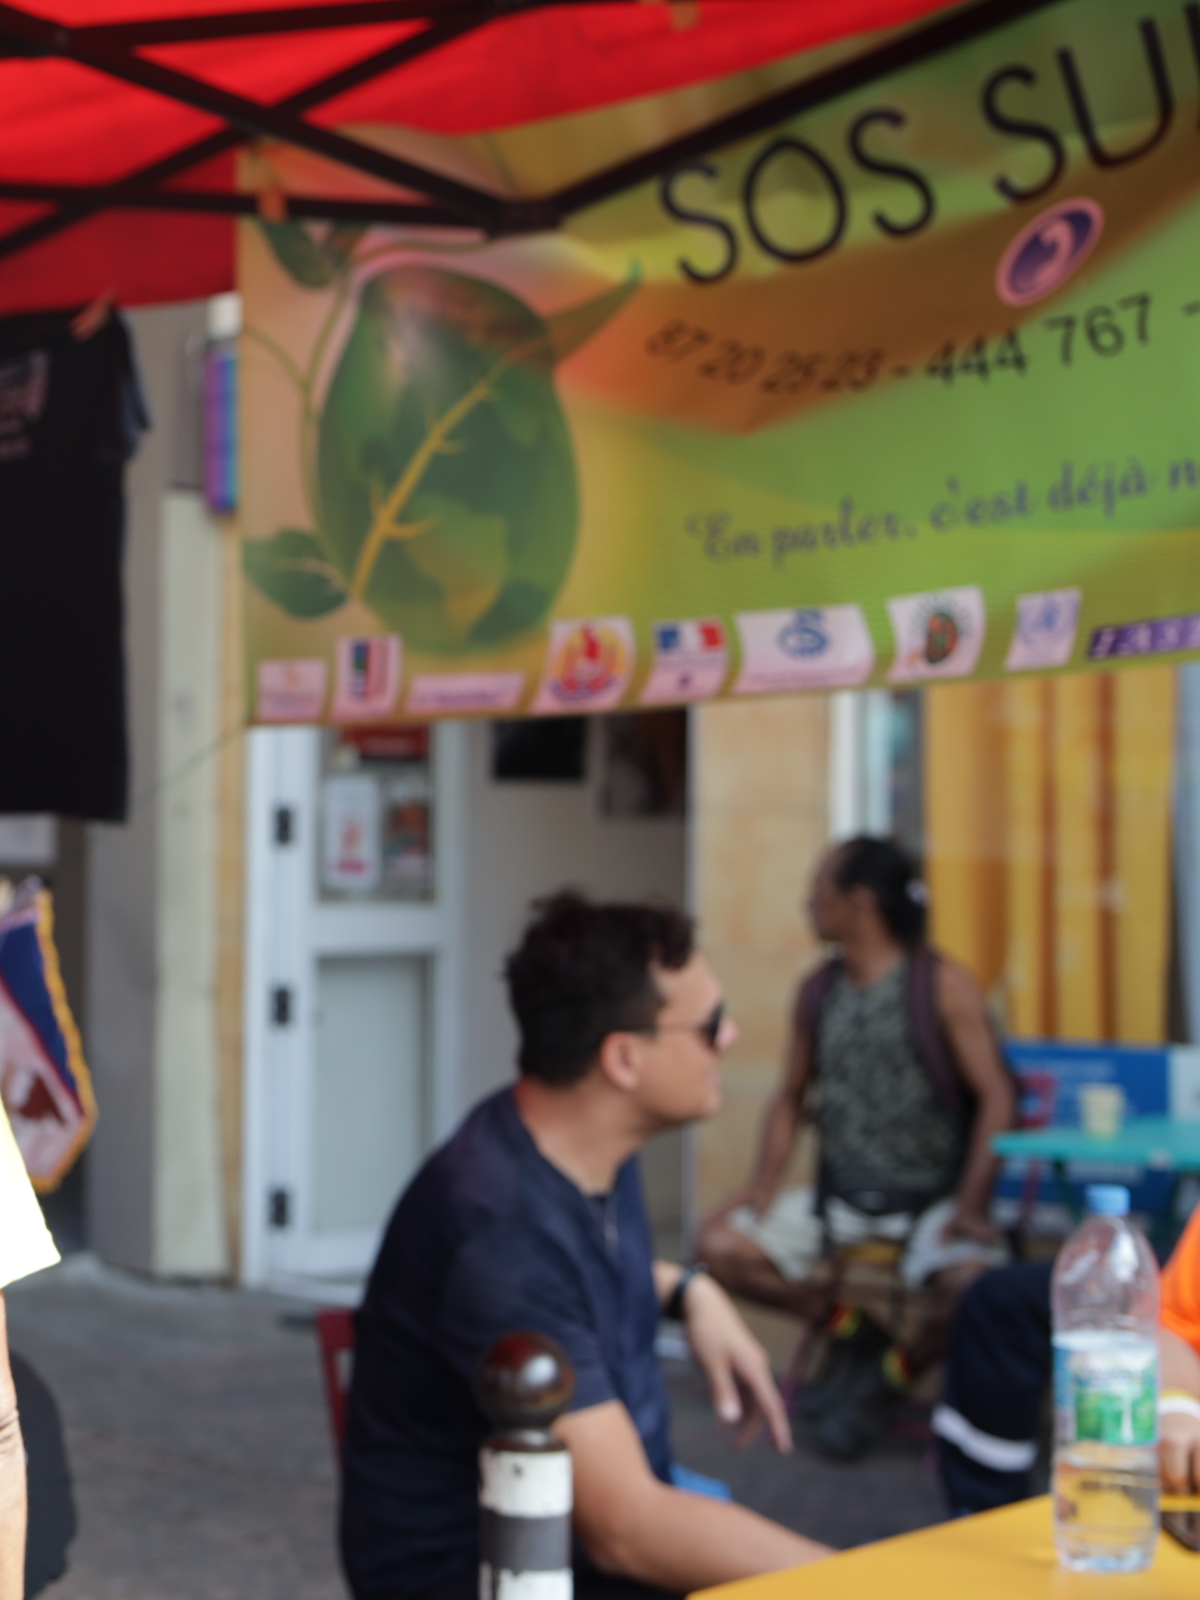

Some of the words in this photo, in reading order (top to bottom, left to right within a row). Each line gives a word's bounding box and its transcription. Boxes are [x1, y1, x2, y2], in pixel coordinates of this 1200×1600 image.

[658, 107, 936, 285] SOS
[698, 338, 767, 386] 20
[925, 327, 1028, 387] 444
[1044, 292, 1153, 367] 767
